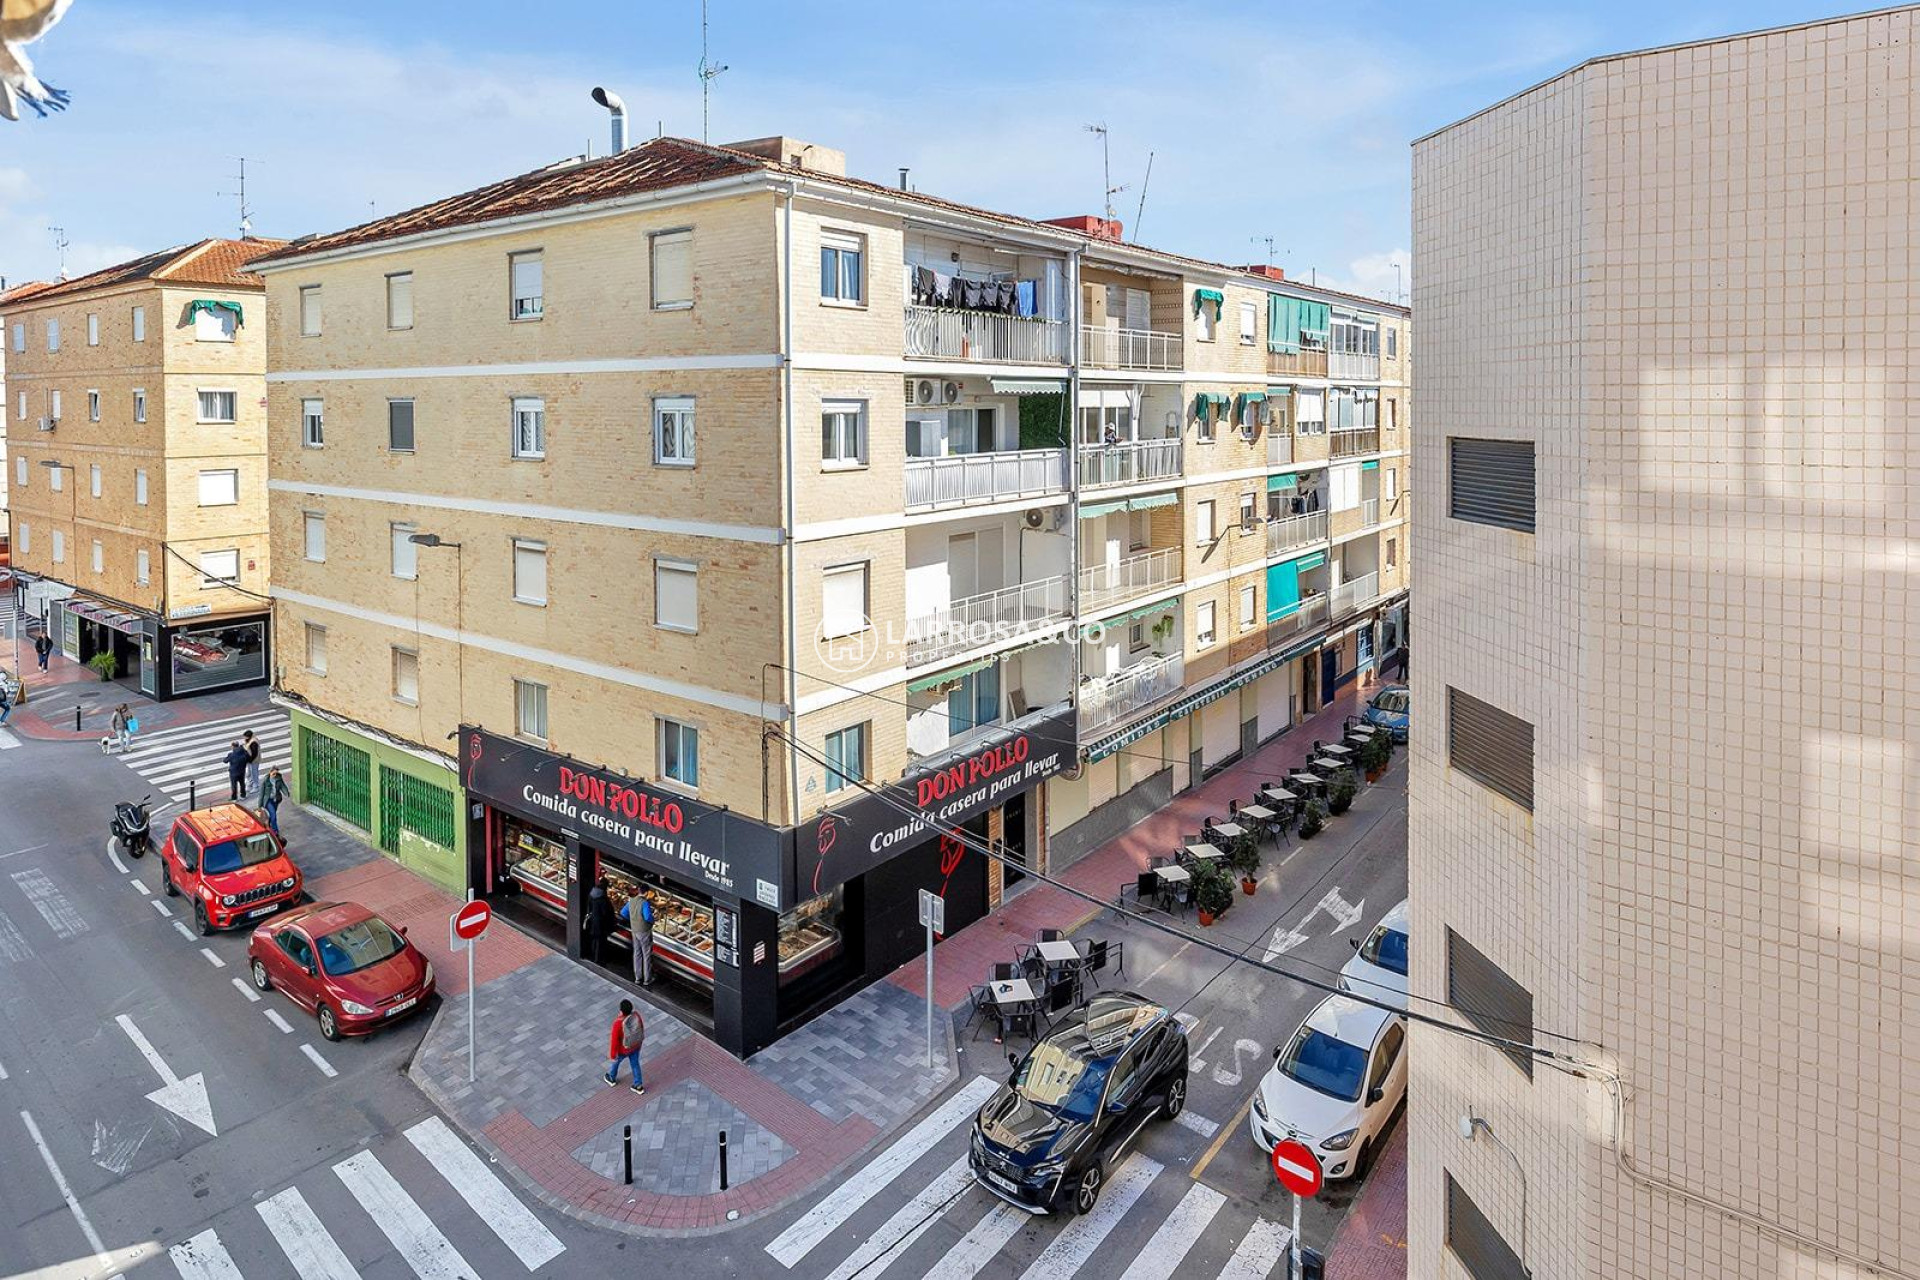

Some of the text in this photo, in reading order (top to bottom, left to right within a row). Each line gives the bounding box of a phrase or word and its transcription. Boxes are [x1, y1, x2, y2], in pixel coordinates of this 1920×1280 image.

[917, 736, 1029, 807] DON POLLO
[1102, 719, 1160, 757] COMIDAS
[523, 784, 577, 819] Comida
[581, 810, 631, 839] casera
[634, 829, 674, 855] para
[679, 840, 731, 876] llevar
[559, 766, 684, 834] DON POLLO
[870, 810, 936, 853] Comida
[939, 787, 986, 820] casera
[989, 769, 1021, 800] para
[1024, 752, 1059, 778] llevar
